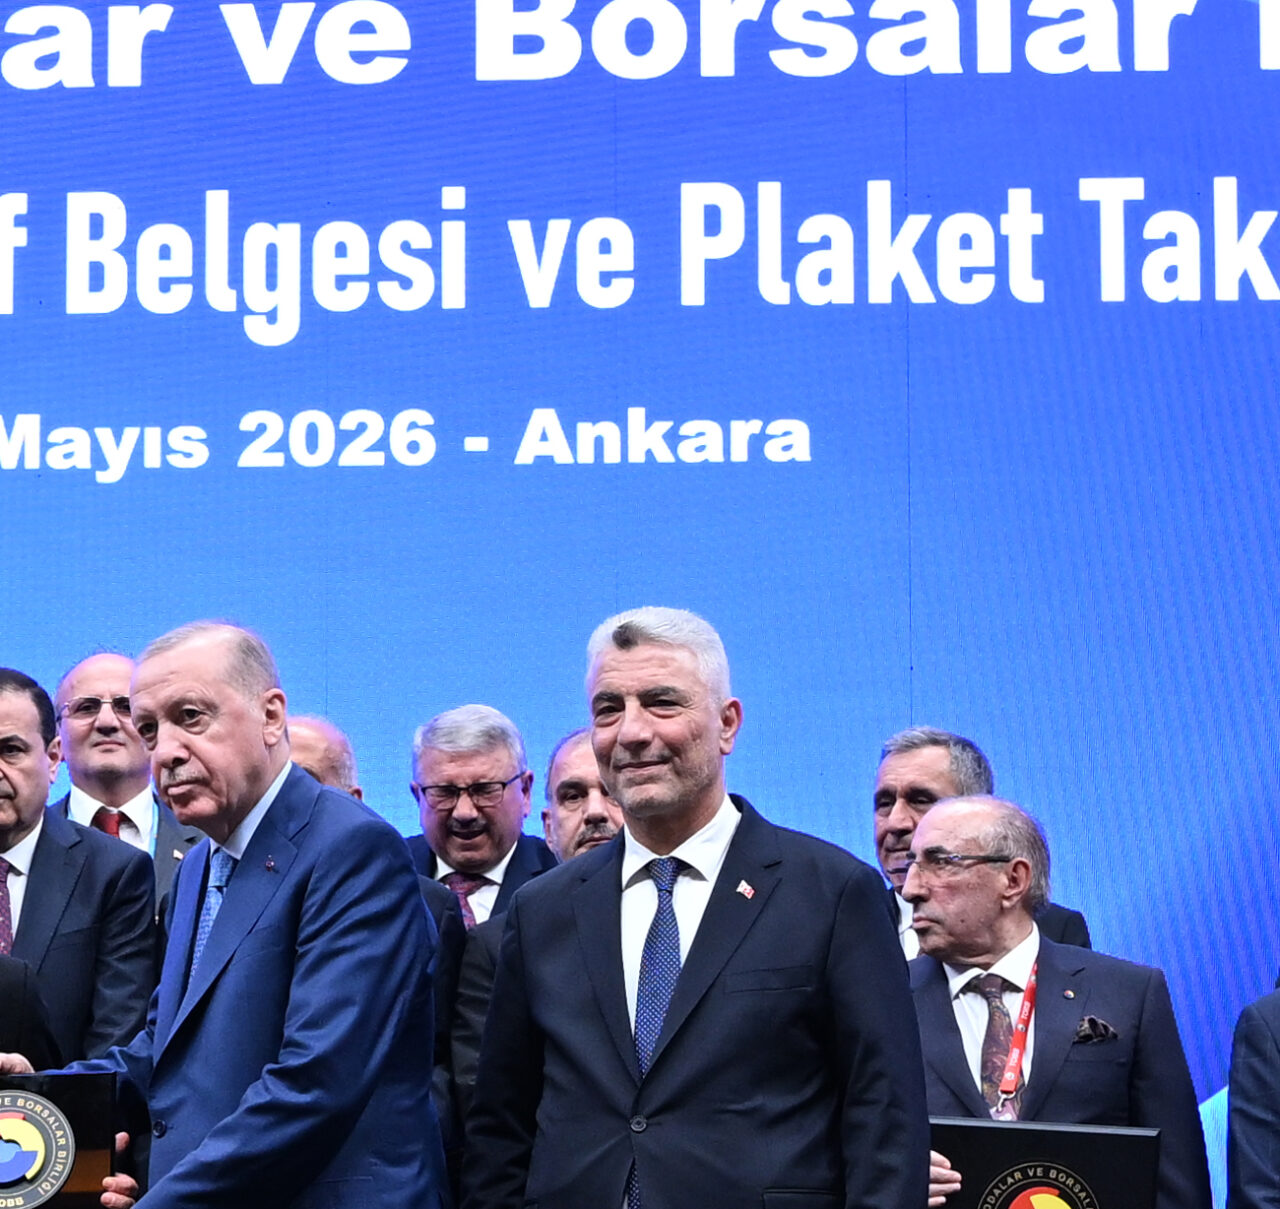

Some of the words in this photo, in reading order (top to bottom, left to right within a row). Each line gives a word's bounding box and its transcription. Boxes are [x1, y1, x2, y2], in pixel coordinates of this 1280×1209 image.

[220, 0, 410, 85] ve
[476, 0, 1197, 81] Borsalar
[66, 186, 466, 347] Belgesi
[507, 217, 635, 309] ve
[680, 180, 1045, 306] Plaket
[237, 409, 437, 467] 2026
[464, 436, 489, 452] -
[514, 407, 811, 465] Ankara
[1027, 1167, 1044, 1177] VE
